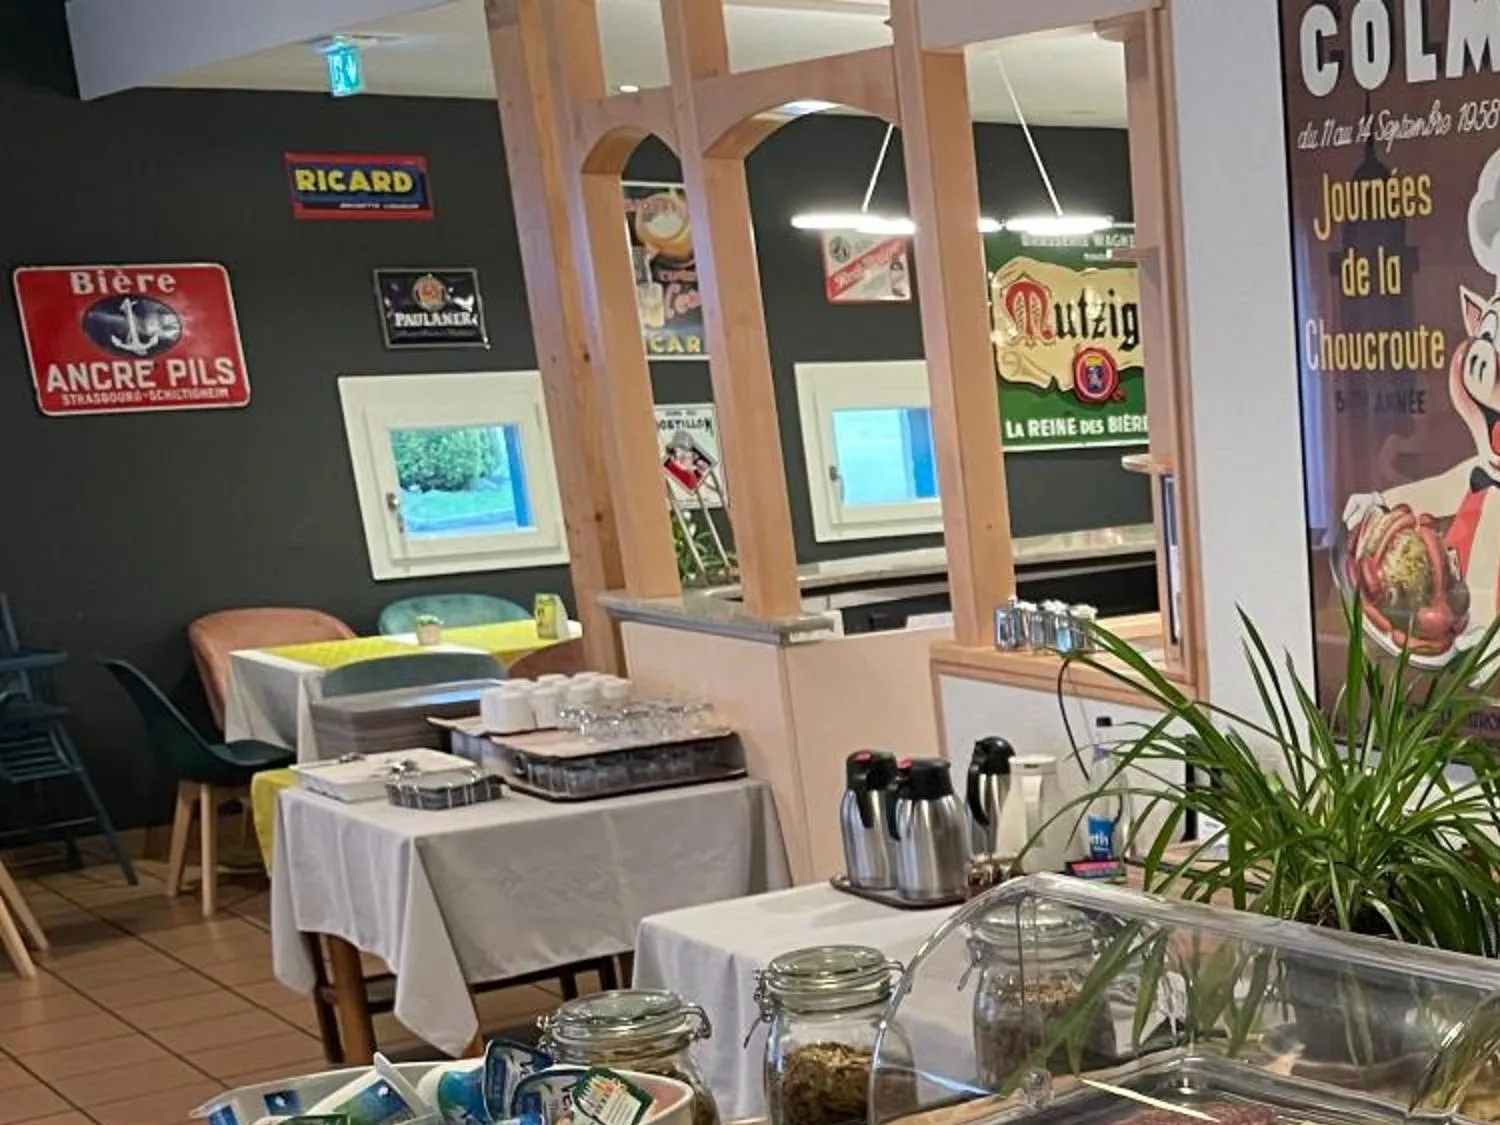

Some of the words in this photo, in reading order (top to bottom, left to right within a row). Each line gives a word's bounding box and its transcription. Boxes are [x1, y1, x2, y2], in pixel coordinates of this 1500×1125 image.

[1374, 98, 1452, 153] Septembre
[294, 169, 414, 193] RICARD
[1313, 166, 1433, 241] Journées
[69, 270, 177, 295] Bière
[1341, 247, 1370, 297] de
[1378, 245, 1402, 296] la
[394, 311, 472, 328] PAULANER
[1004, 278, 1140, 352] Mutzig
[1305, 319, 1446, 372] Choucroute
[46, 360, 157, 393] ANCRE
[167, 357, 237, 388] PILS
[1005, 420, 1025, 440] LA
[1028, 417, 1077, 438] REINE
[1080, 418, 1105, 436] DES
